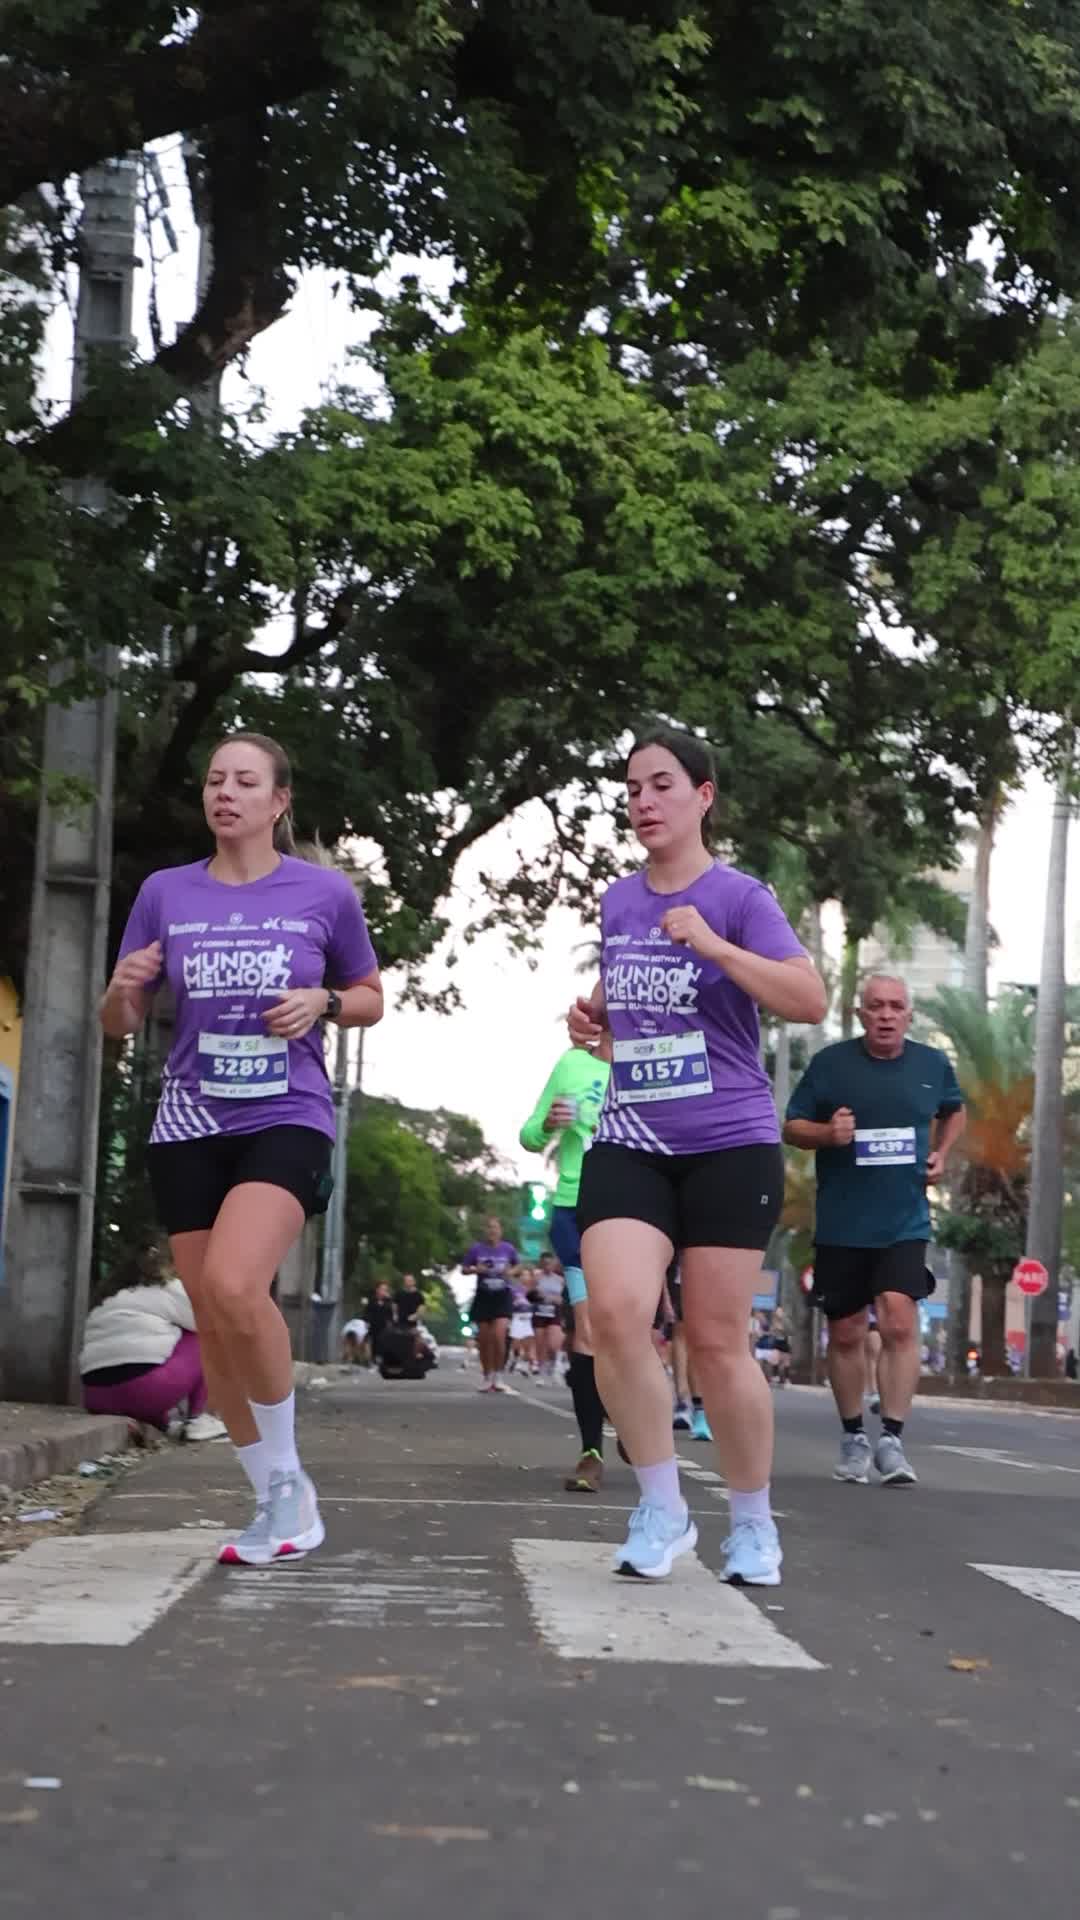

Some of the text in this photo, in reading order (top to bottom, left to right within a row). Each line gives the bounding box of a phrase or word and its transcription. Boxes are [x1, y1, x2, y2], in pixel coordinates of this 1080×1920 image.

[184, 951, 273, 971] MUNDO
[606, 965, 681, 986] MUNDO
[606, 982, 681, 1004] MELHOR
[213, 1057, 268, 1076] 5289
[631, 1059, 684, 1081] 6157
